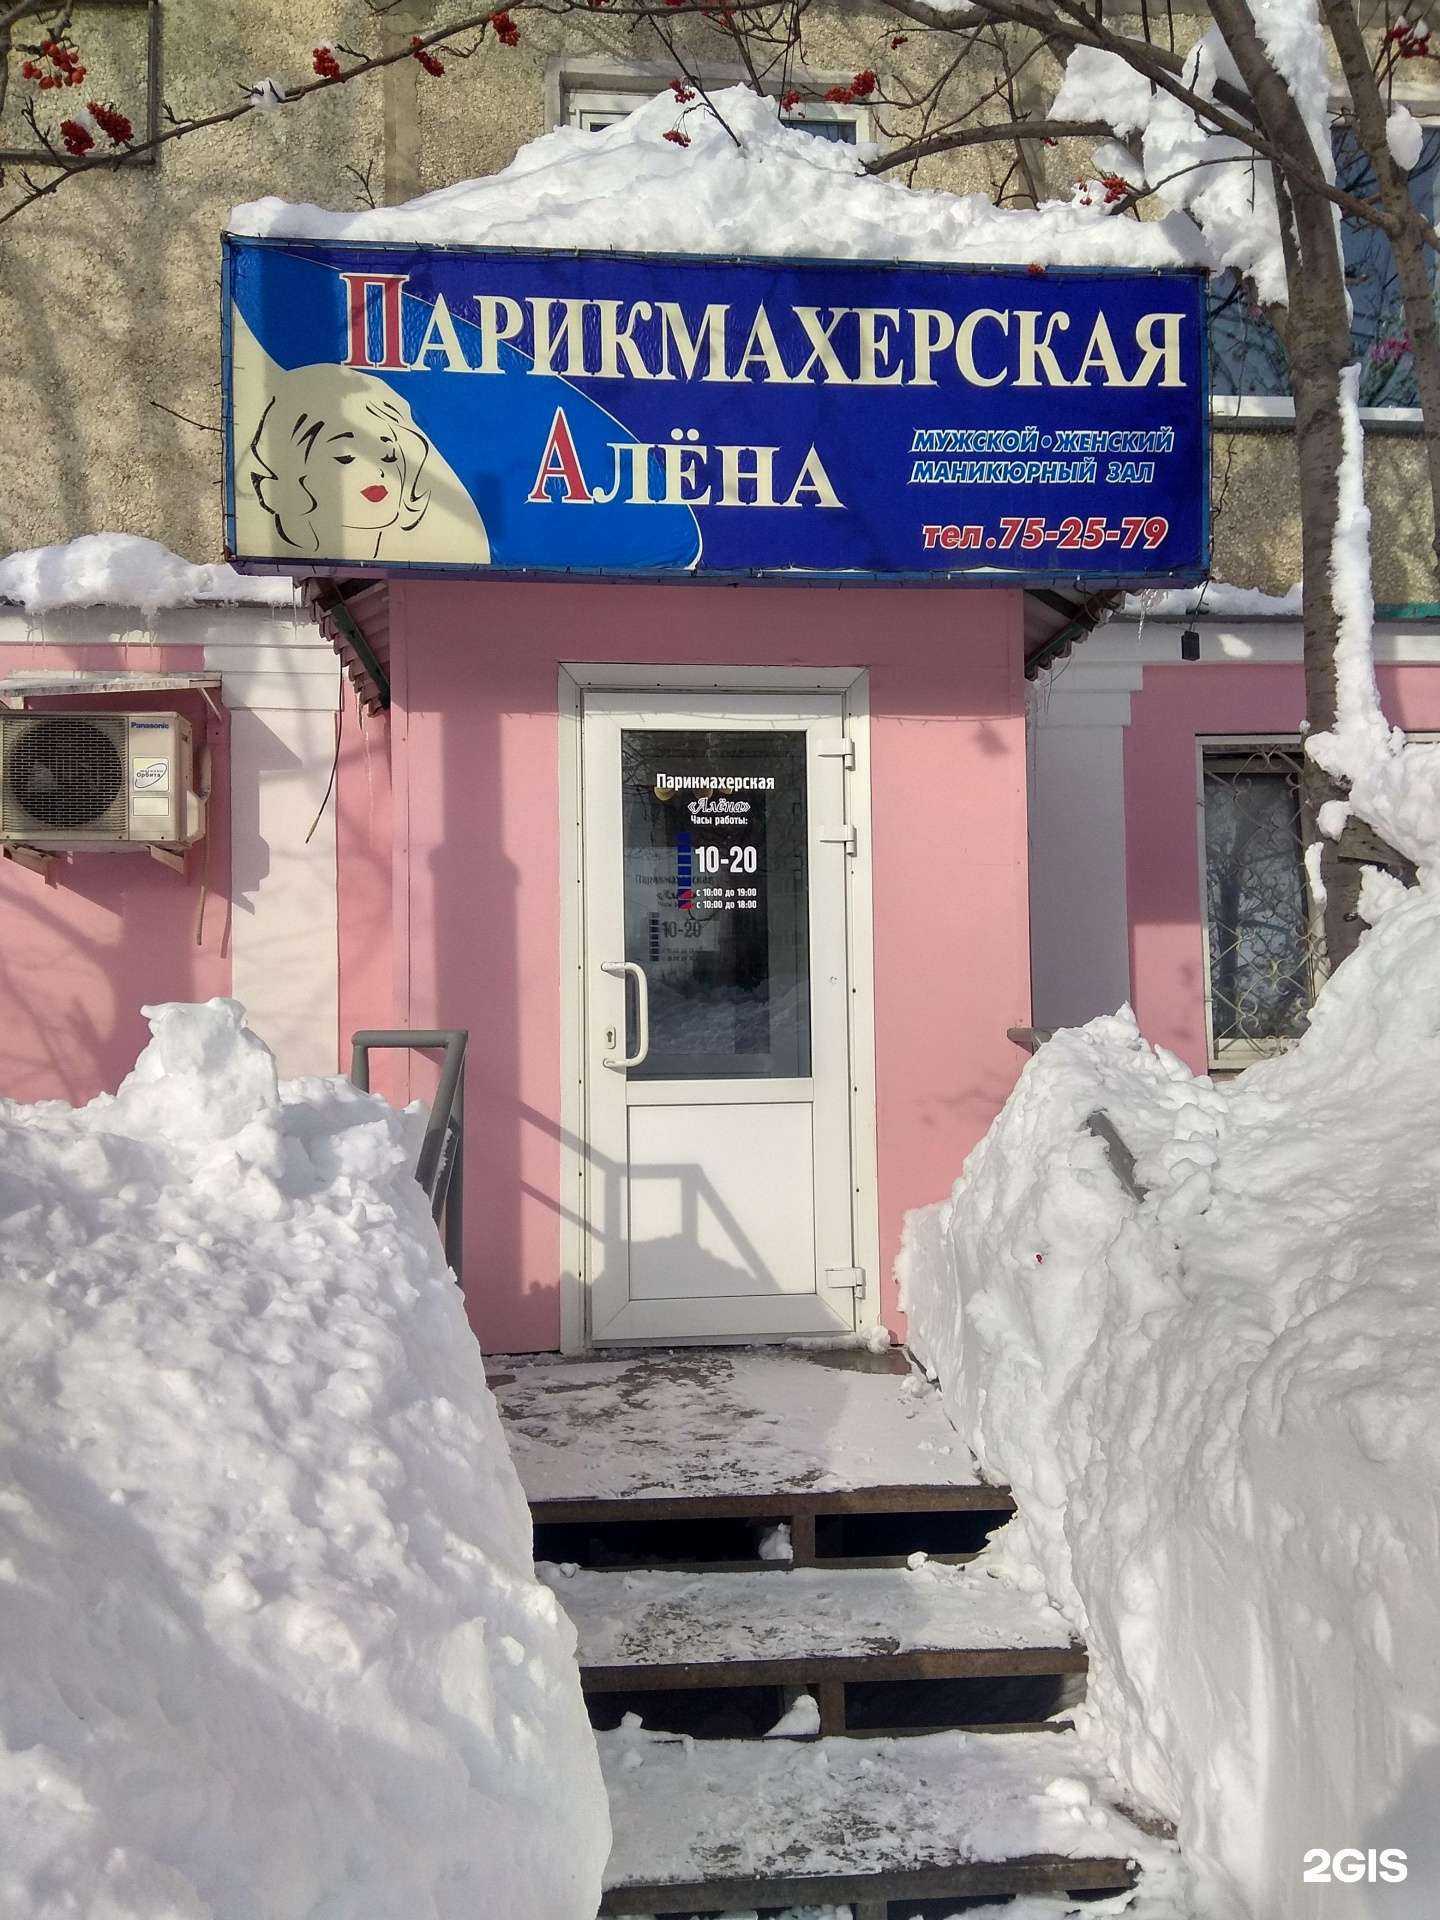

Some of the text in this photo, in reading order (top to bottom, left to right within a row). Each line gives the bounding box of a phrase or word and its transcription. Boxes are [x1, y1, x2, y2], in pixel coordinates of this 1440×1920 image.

[338, 272, 1188, 388] ПАРИКМАХЕРСКАЯ
[525, 406, 848, 509] АЛЁНА
[908, 456, 1155, 485] МАНИКЮРНЫЙ ЗАЛ
[656, 773, 775, 791] Парикмахерская
[691, 815, 748, 826] Часы работы:
[695, 845, 757, 873] 10-20
[702, 888, 723, 897] 10:00
[725, 889, 735, 898] до
[736, 888, 757, 897] 19:00
[702, 900, 723, 909] 10:00
[725, 901, 735, 910] до
[736, 900, 757, 909] 18:00
